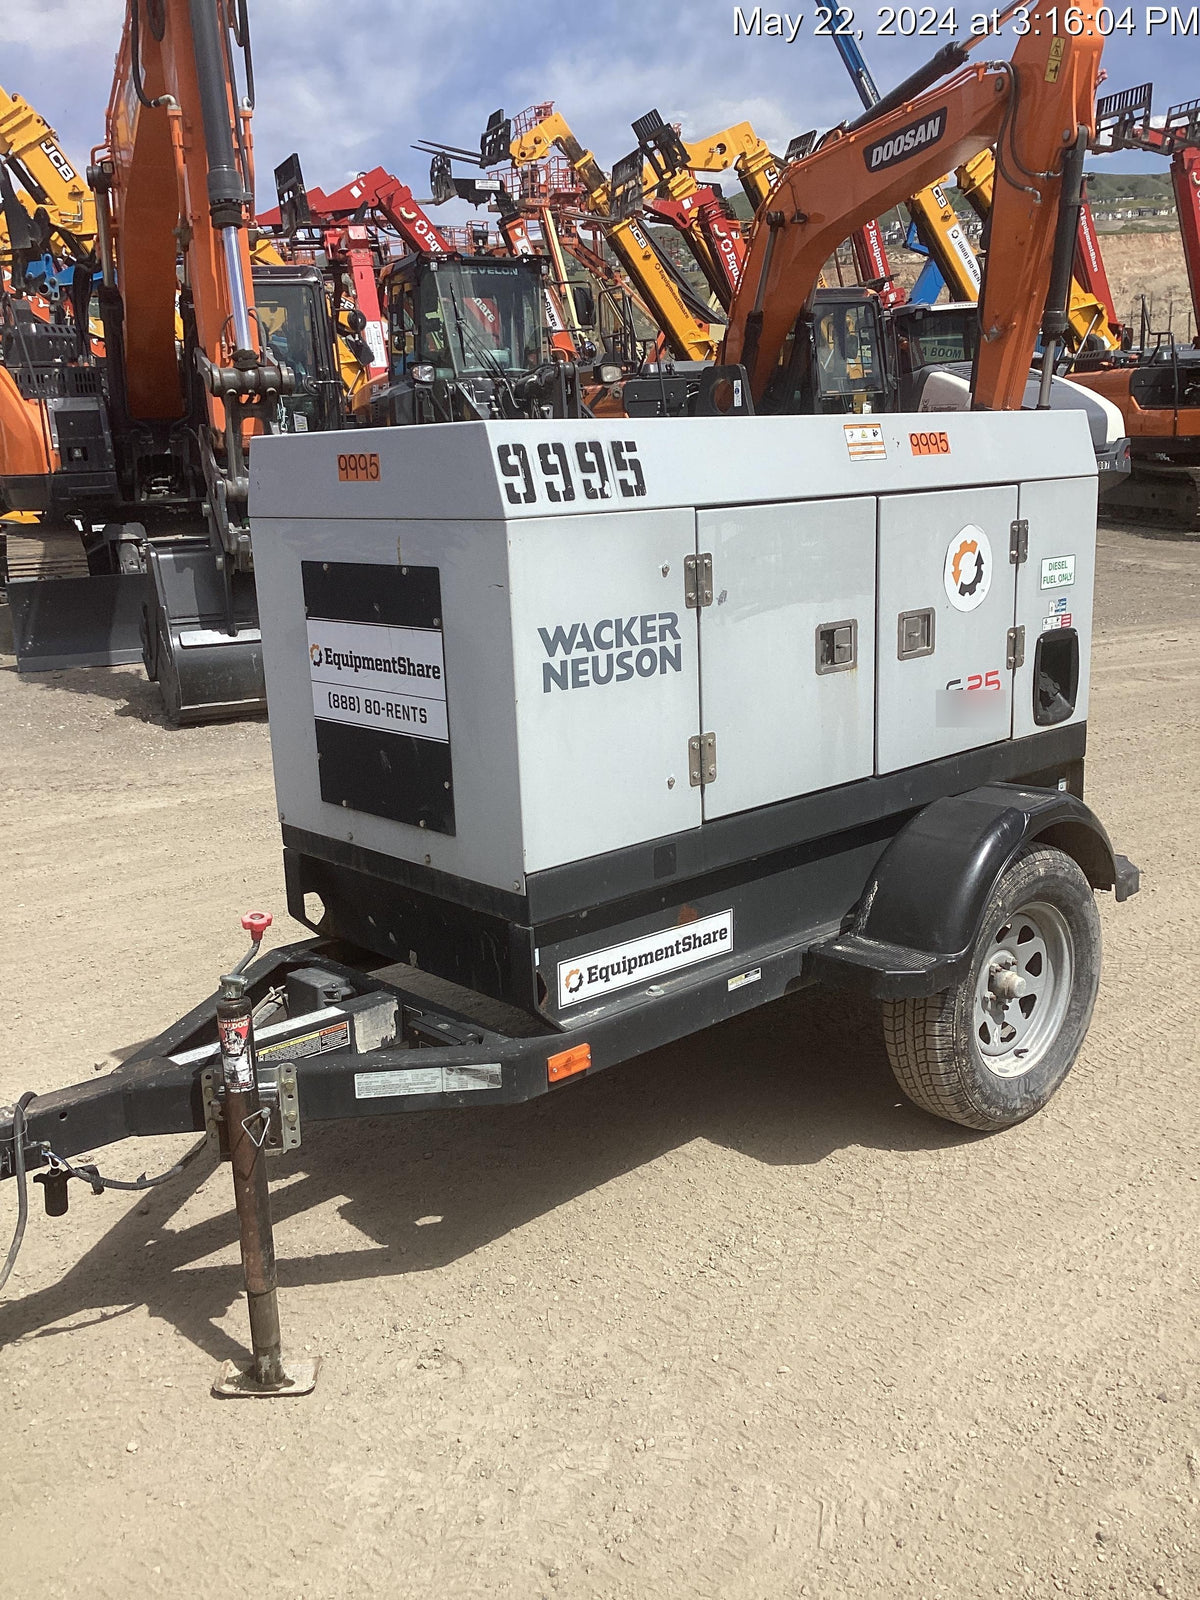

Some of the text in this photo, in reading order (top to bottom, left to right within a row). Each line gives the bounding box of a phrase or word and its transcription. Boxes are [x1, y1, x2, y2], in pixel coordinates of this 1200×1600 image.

[871, 116, 941, 168] DOOSAN
[40, 139, 76, 182] JCB
[628, 224, 648, 249] JCB
[930, 347, 962, 359] BOOM
[910, 432, 950, 454] 9995
[338, 454, 379, 480] 9995
[497, 440, 648, 505] 9995
[1043, 572, 1073, 585] FUEL ONLY
[1048, 560, 1069, 571] DIESEL
[537, 611, 682, 658] WACKER
[324, 647, 442, 680] EquipmentShare
[542, 643, 682, 694] NEUSON
[328, 691, 428, 724] (888) 80-RENTS
[586, 926, 728, 984] EquipmentShare
